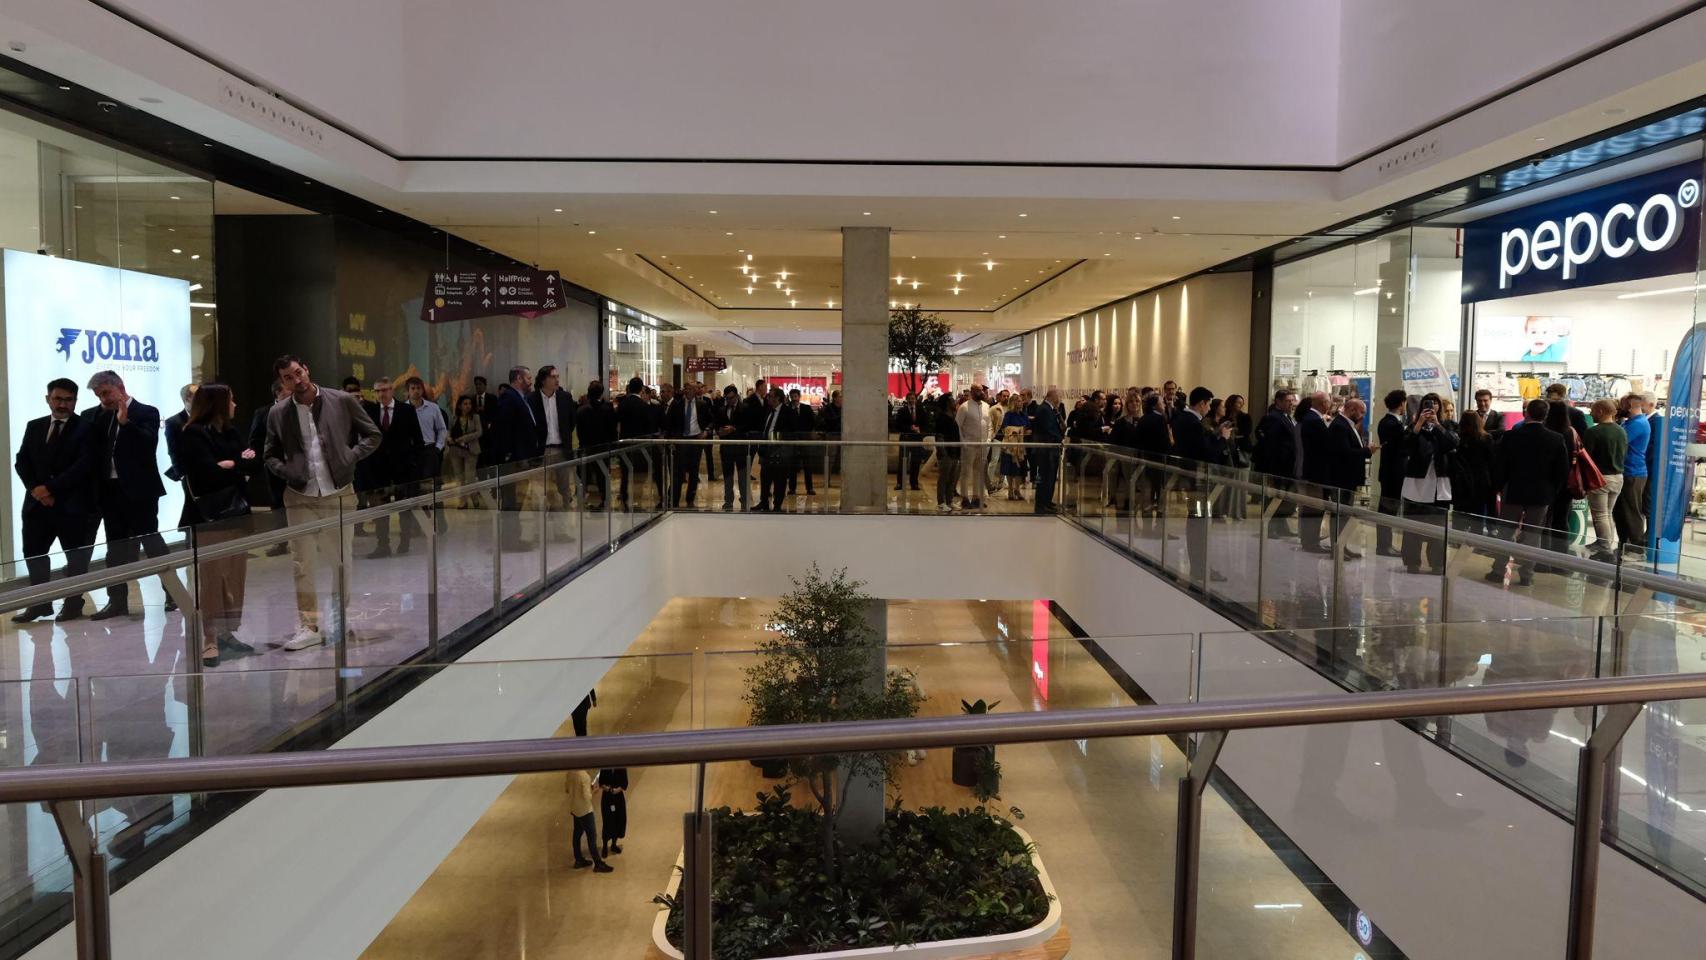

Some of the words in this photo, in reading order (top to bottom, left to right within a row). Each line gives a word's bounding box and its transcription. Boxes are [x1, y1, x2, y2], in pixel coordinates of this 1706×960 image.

[1500, 193, 1677, 289] pepco
[499, 275, 531, 283] HalfPrice
[428, 308, 435, 320] 1
[1404, 370, 1434, 380] pepco
